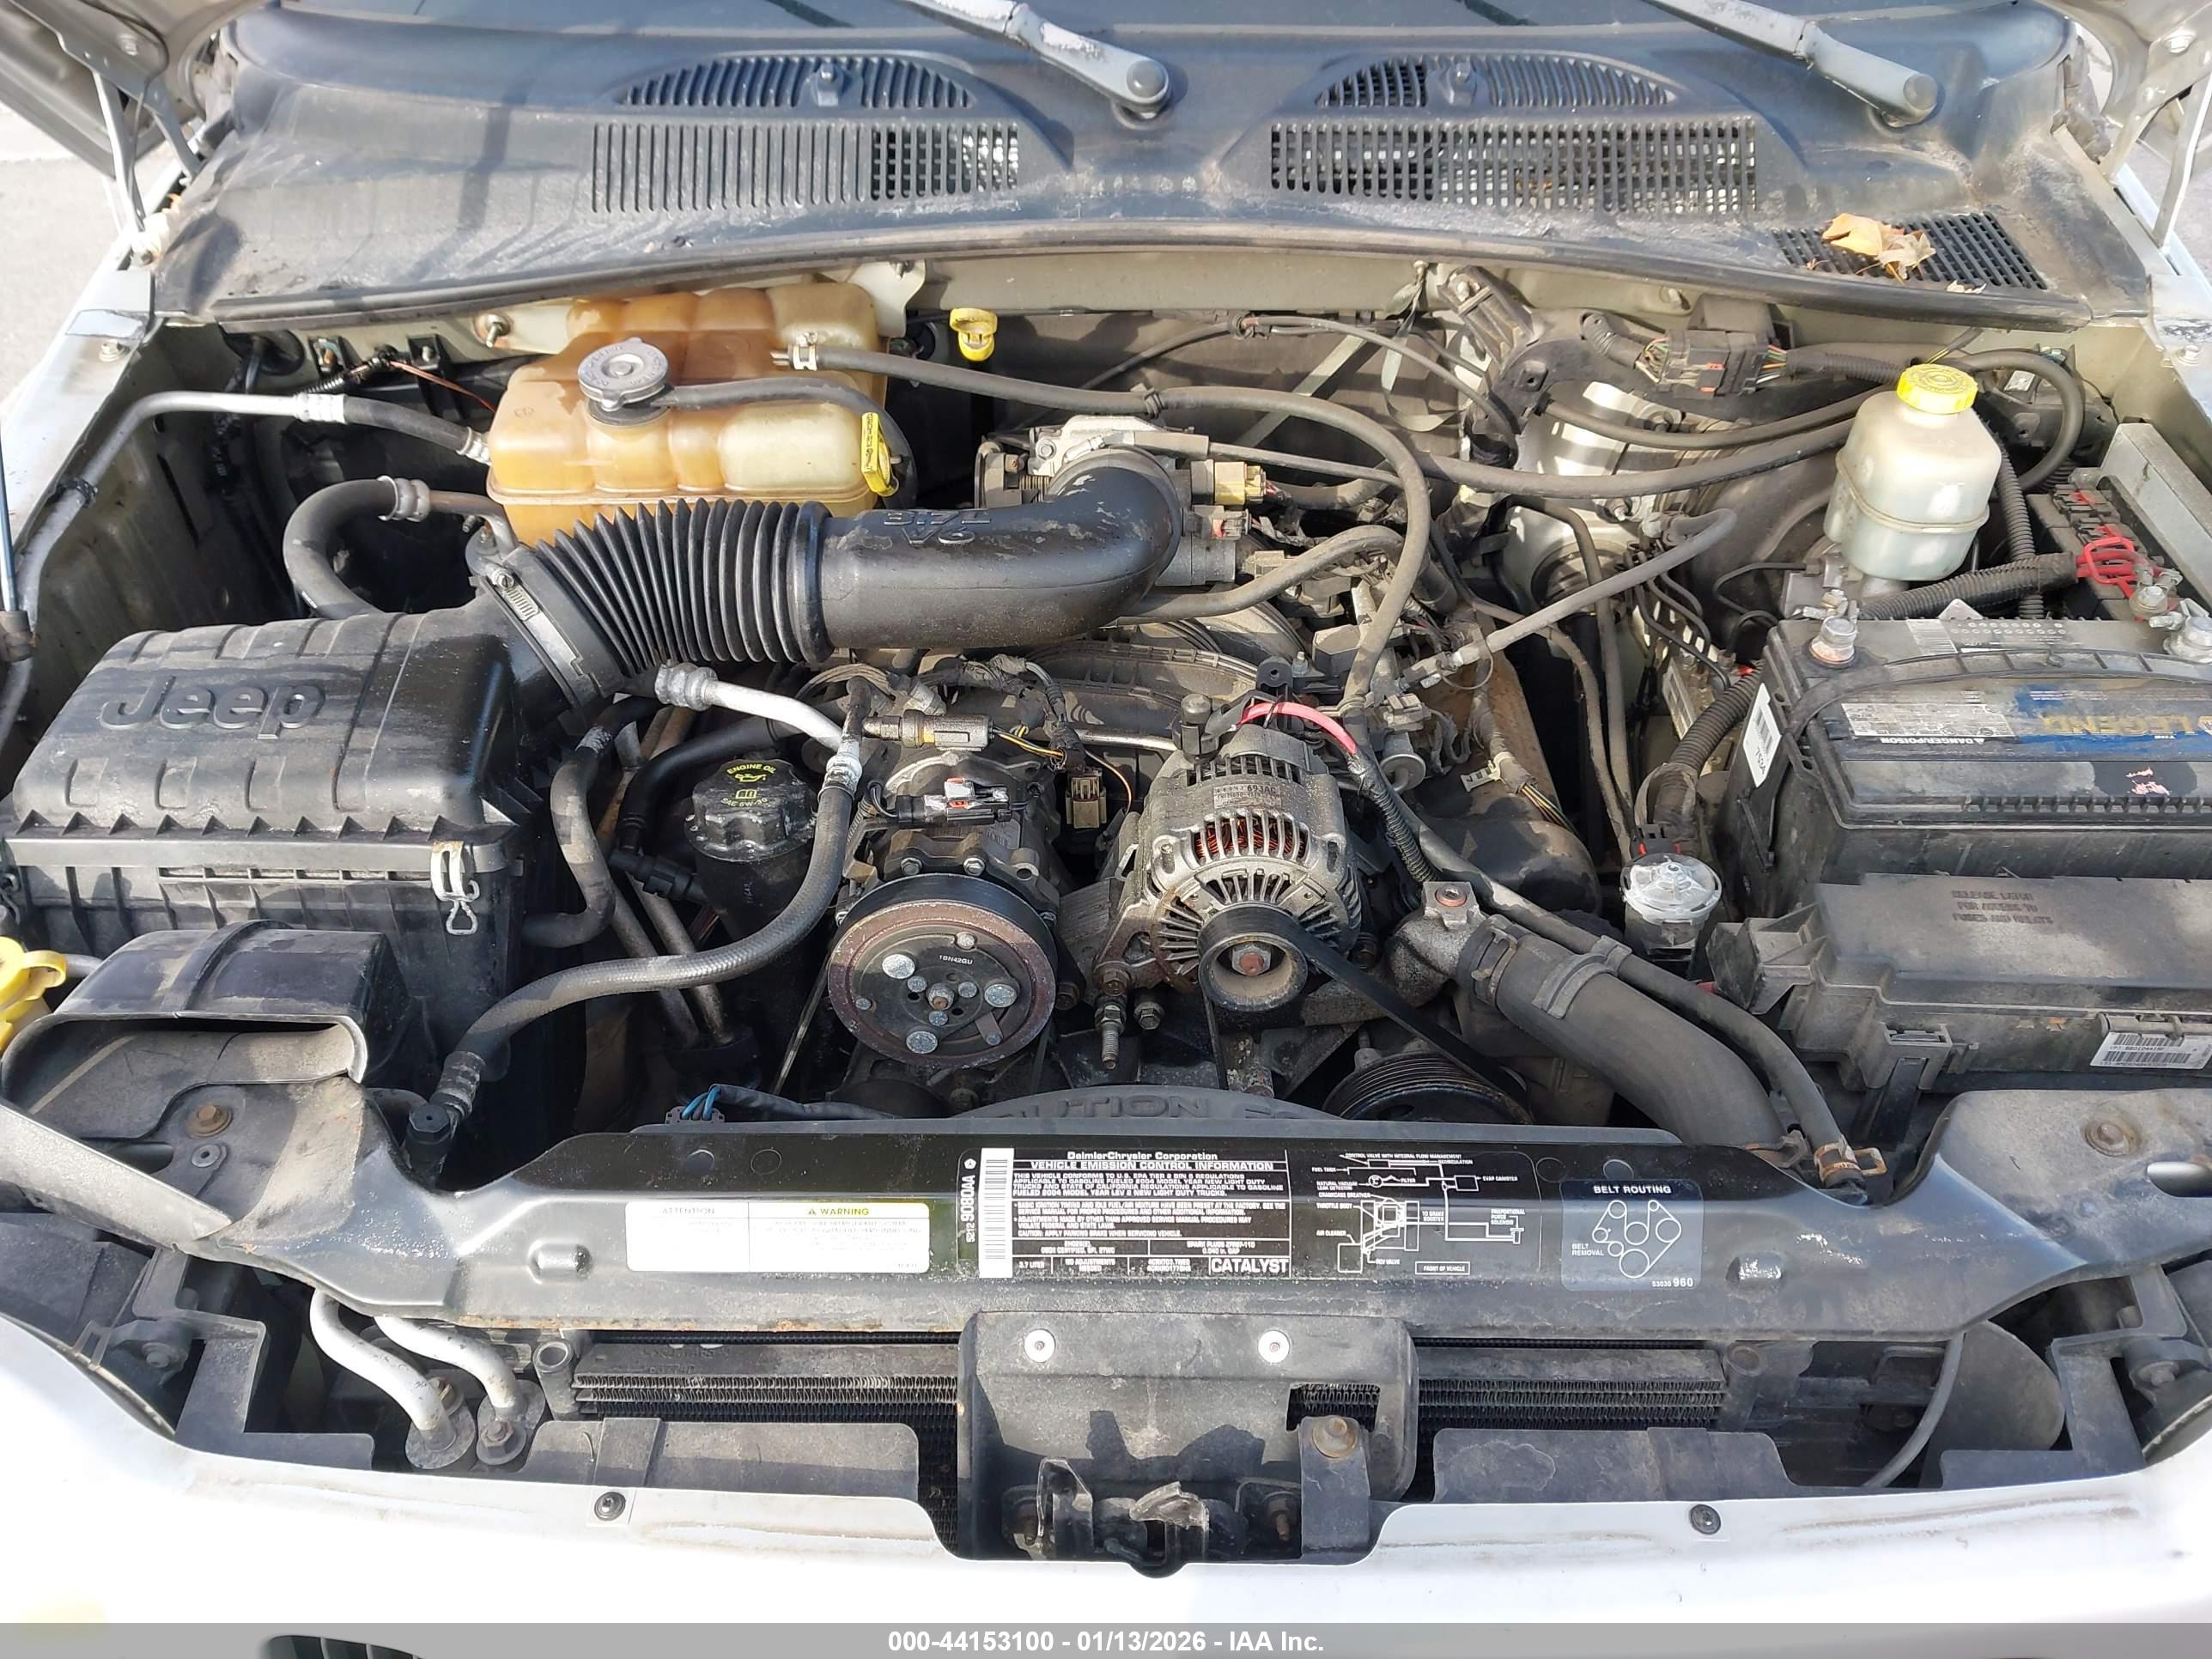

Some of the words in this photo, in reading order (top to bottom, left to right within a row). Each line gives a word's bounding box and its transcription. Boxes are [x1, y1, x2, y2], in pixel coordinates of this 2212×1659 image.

[902, 526, 975, 544] V6
[97, 676, 326, 739] Jeep
[726, 763, 763, 775] ENGINE
[763, 764, 777, 774] OIL
[720, 797, 737, 807] SAE
[1067, 1151, 1152, 1162] DaimlerChrysler
[1155, 1151, 1218, 1162] Corporation
[1030, 1161, 1077, 1170] VEHICLE
[1080, 1161, 1137, 1170] EMISSION
[1139, 1161, 1194, 1170] CONTROL
[1195, 1162, 1273, 1170] INFORMATION
[1623, 1186, 1672, 1194] ROUTING
[819, 1207, 870, 1216] WARNING
[1212, 1258, 1289, 1273] CATALYST
[1672, 1278, 1693, 1287] 960
